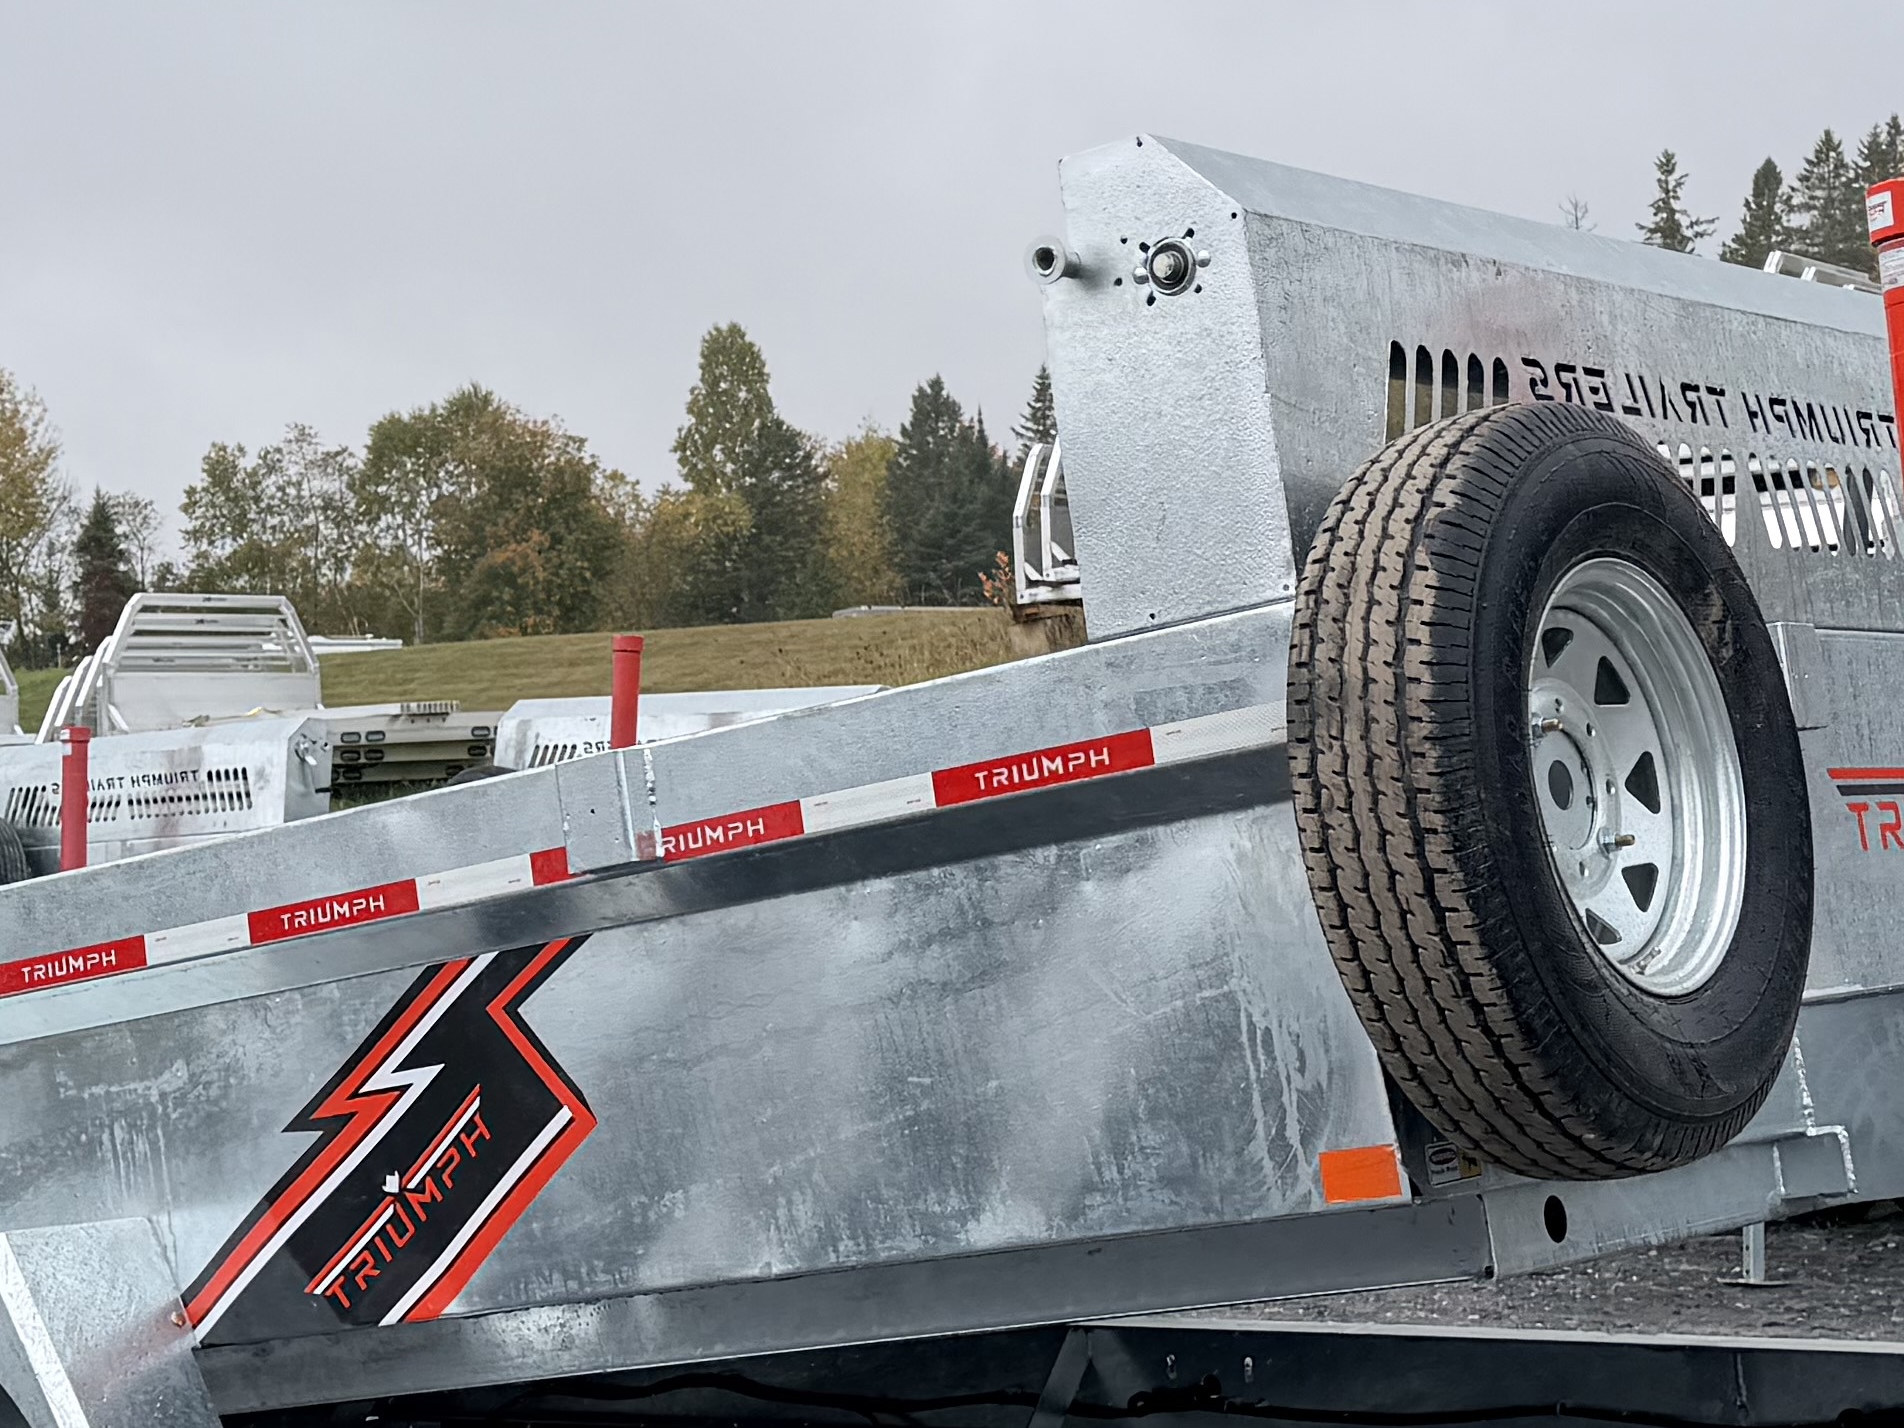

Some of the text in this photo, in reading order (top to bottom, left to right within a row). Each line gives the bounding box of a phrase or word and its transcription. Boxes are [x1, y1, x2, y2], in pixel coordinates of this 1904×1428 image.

[975, 747, 1110, 791] TRIUMPH
[662, 818, 765, 854] RIUMPH
[280, 894, 386, 930] TRIUMPH
[21, 948, 117, 984] TRIUMPH
[324, 1111, 493, 1309] TRIUMPH
